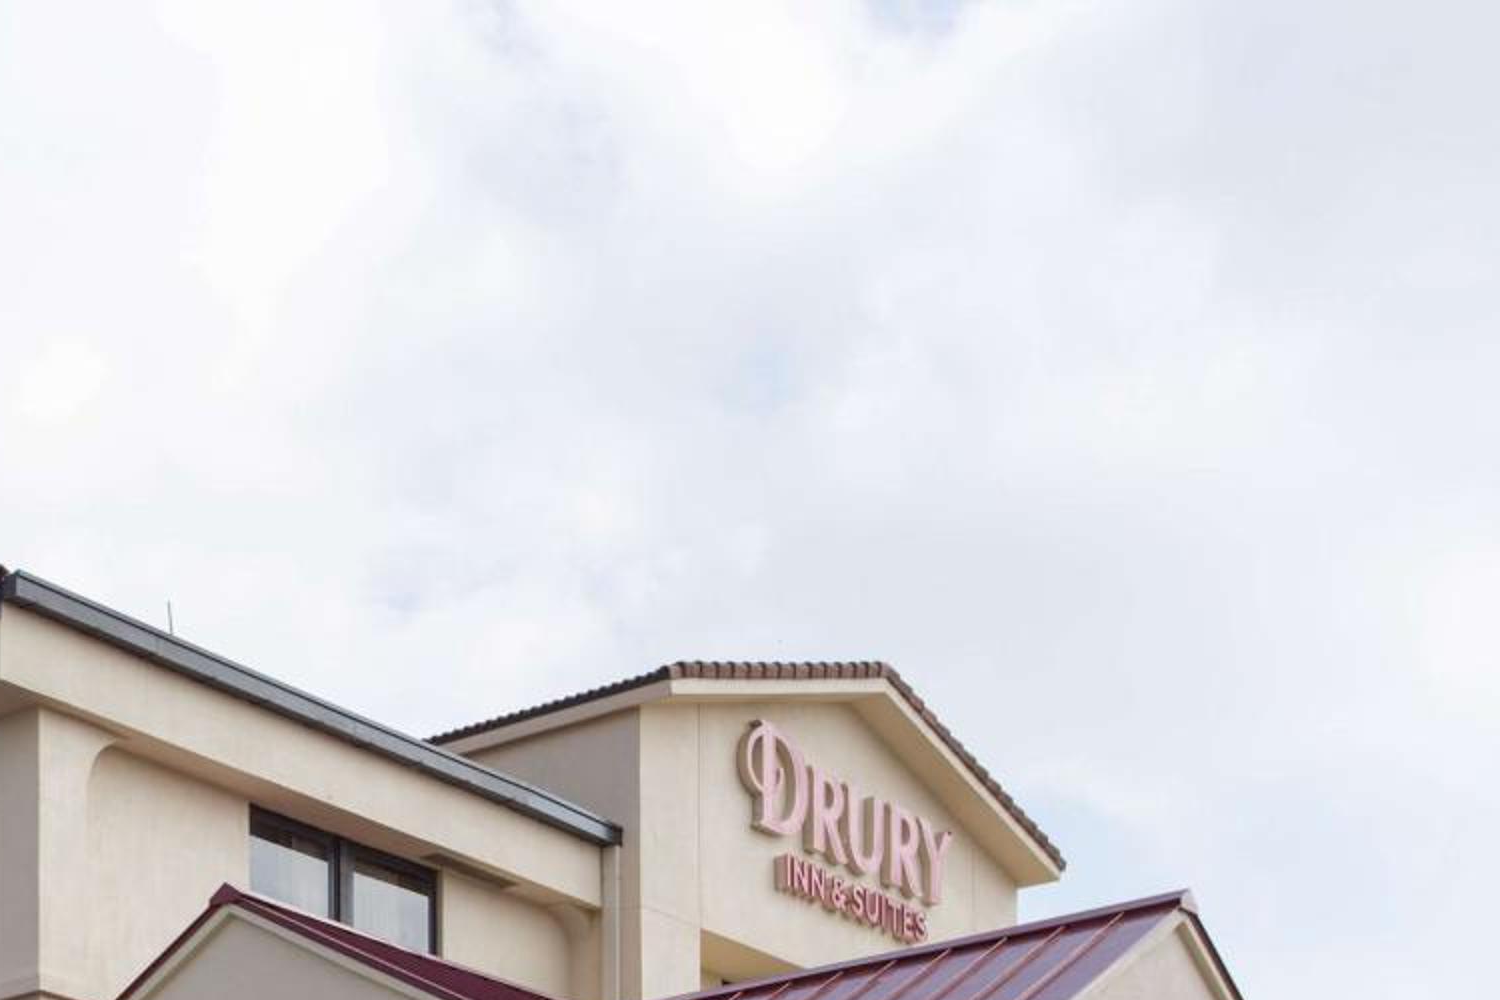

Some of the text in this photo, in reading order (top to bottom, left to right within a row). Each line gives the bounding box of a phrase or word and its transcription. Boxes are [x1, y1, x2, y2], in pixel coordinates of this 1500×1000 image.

[737, 719, 953, 906] DRURY
[776, 851, 929, 944] INN & SUITES
